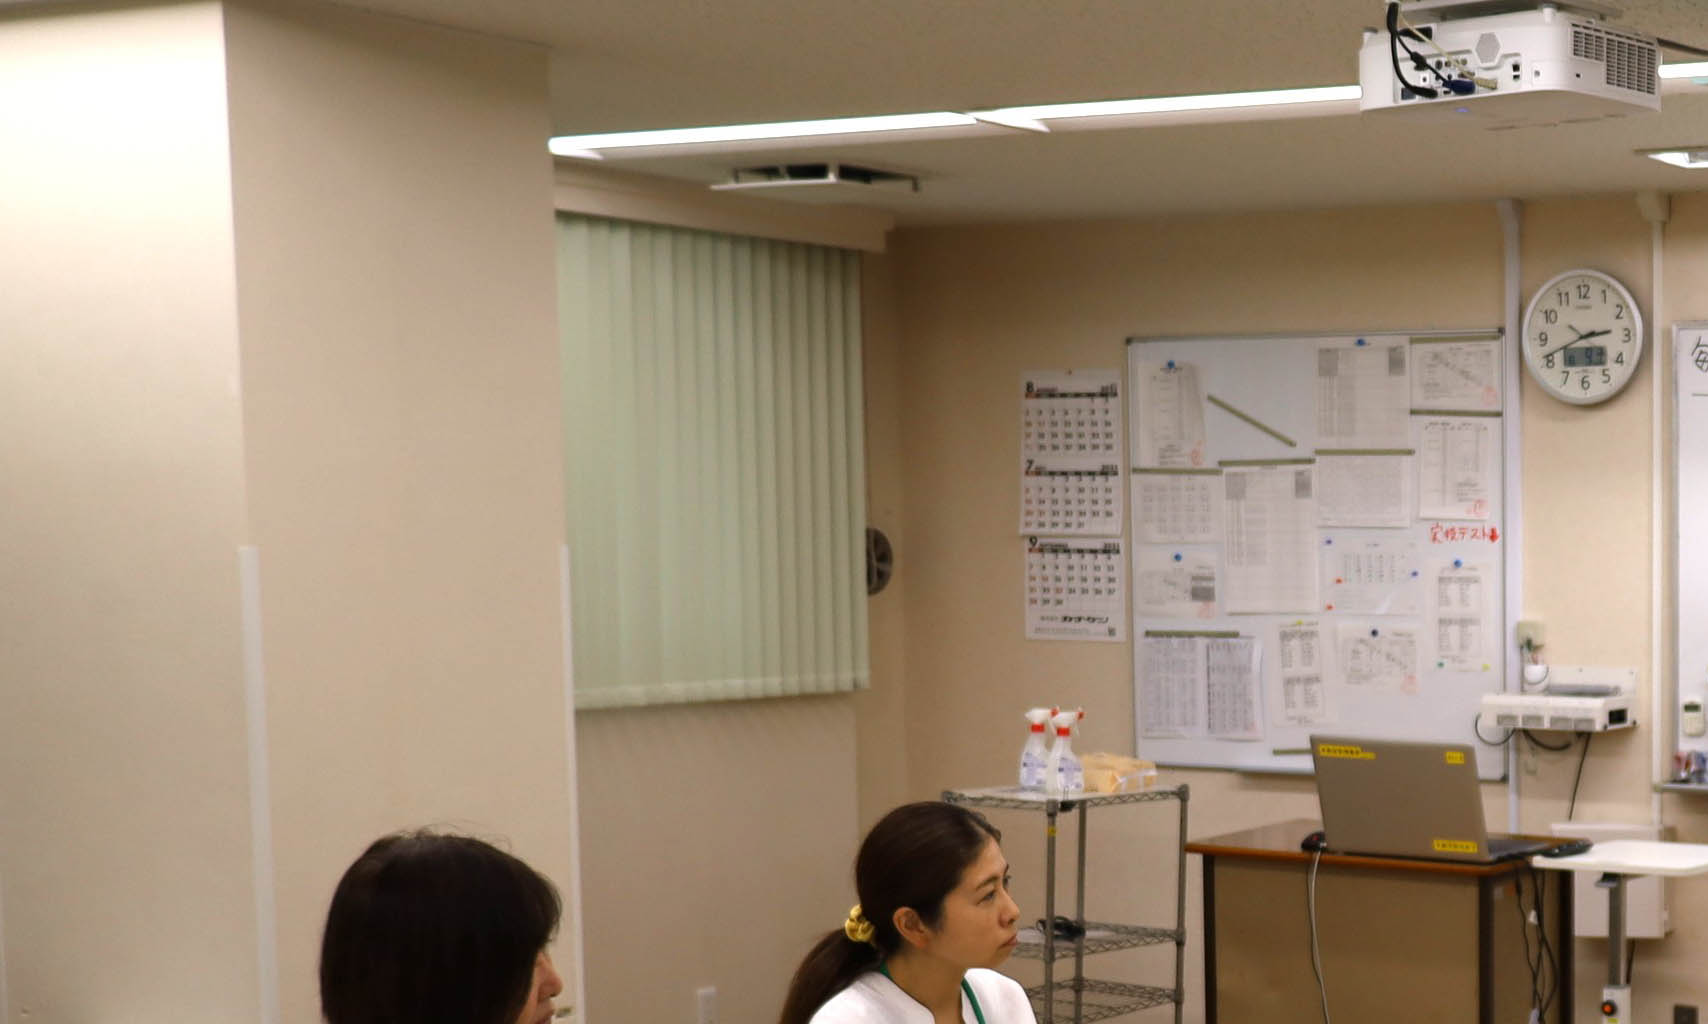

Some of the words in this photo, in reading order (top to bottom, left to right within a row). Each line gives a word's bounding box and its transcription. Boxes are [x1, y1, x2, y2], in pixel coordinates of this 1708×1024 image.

[1558, 292, 1570, 306] 11
[1576, 284, 1591, 299] 12
[1601, 289, 1607, 304] 1
[1544, 309, 1558, 324] 10
[1615, 304, 1624, 320] 2
[1539, 332, 1548, 347] 9
[1623, 328, 1631, 343] 3
[1546, 354, 1555, 369] 8
[1614, 352, 1624, 366] 4
[1561, 370, 1570, 385] 7
[1581, 376, 1590, 390] 6
[1602, 368, 1611, 383] 5
